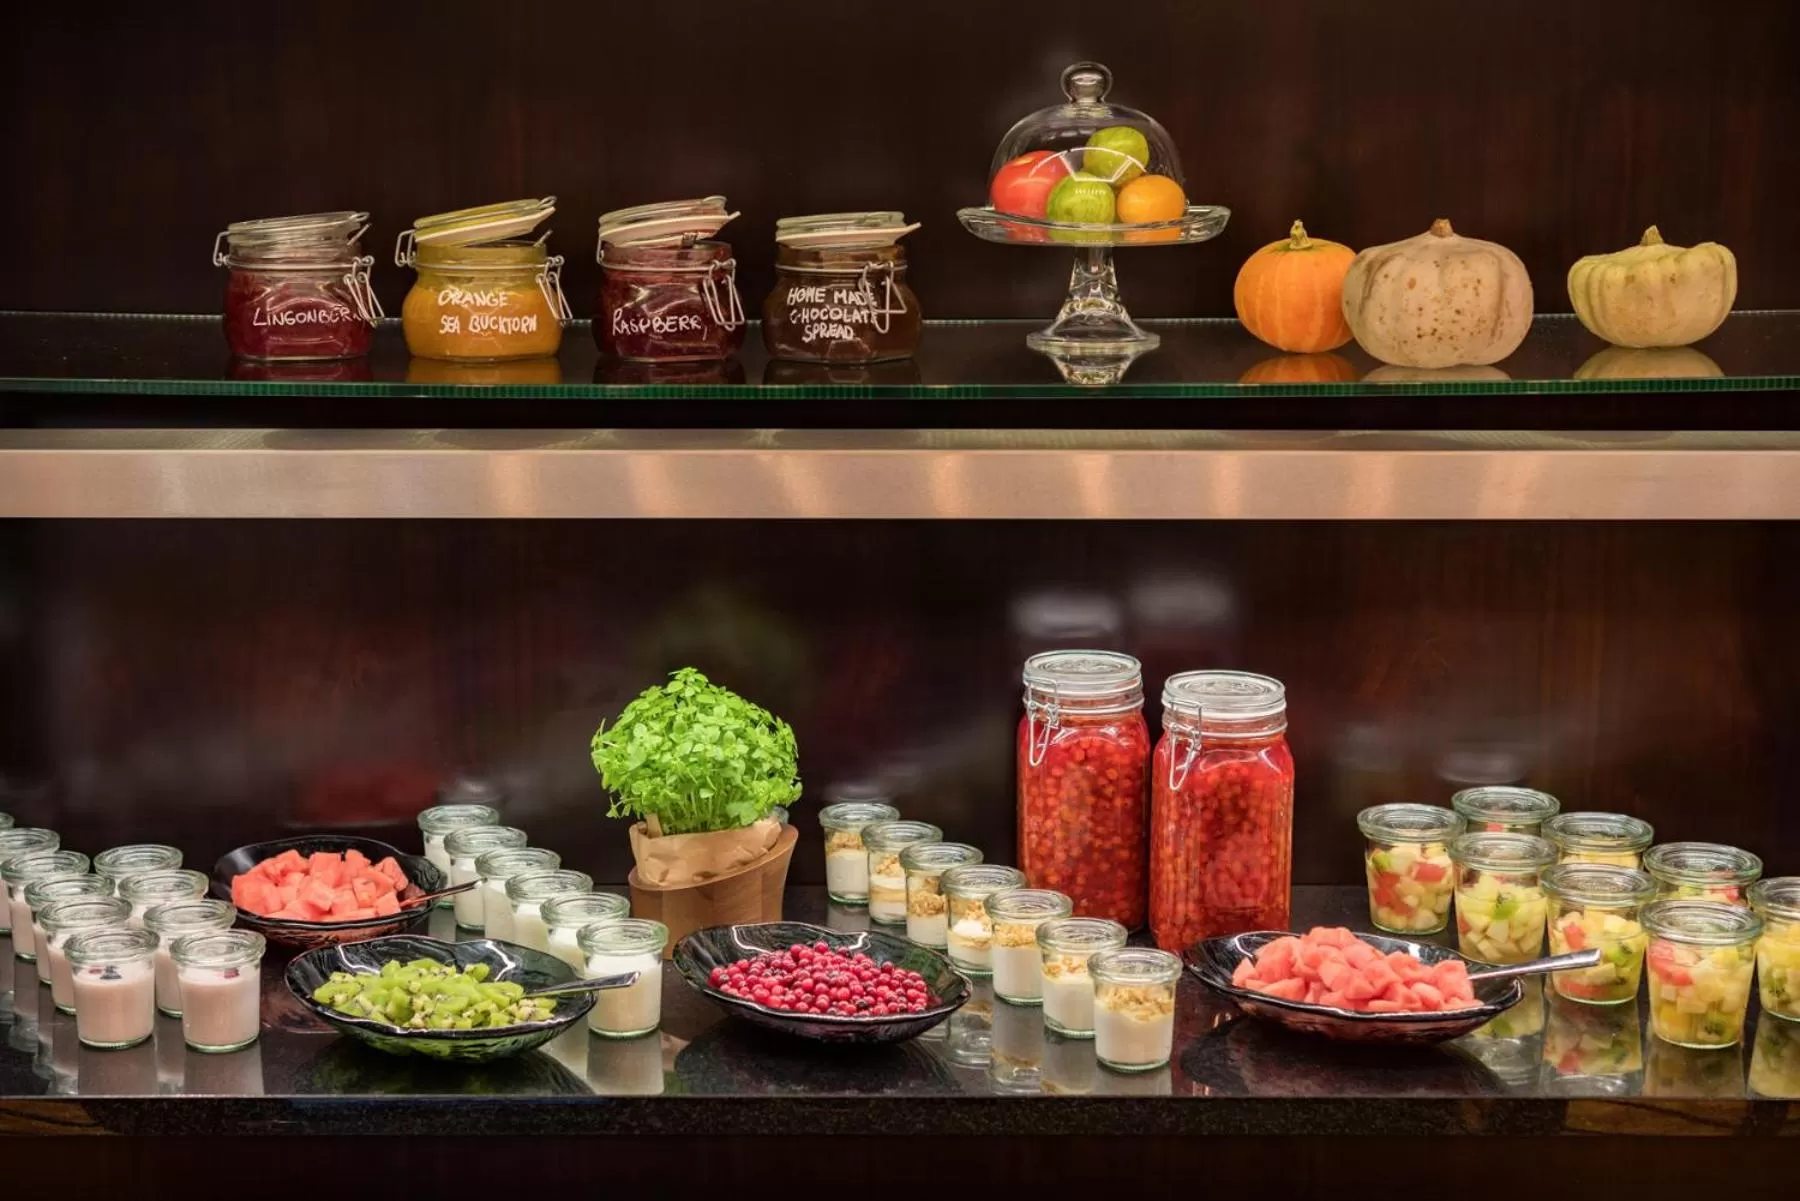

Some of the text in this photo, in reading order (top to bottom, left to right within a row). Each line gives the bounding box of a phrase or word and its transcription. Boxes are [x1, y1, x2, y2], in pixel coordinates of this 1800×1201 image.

[437, 289, 509, 308] ORANGE
[787, 287, 827, 306] HOME
[439, 313, 537, 335] SEA BUCKTORN
[790, 307, 879, 325] CHOCOLATE
[802, 322, 855, 343] SPREAD
